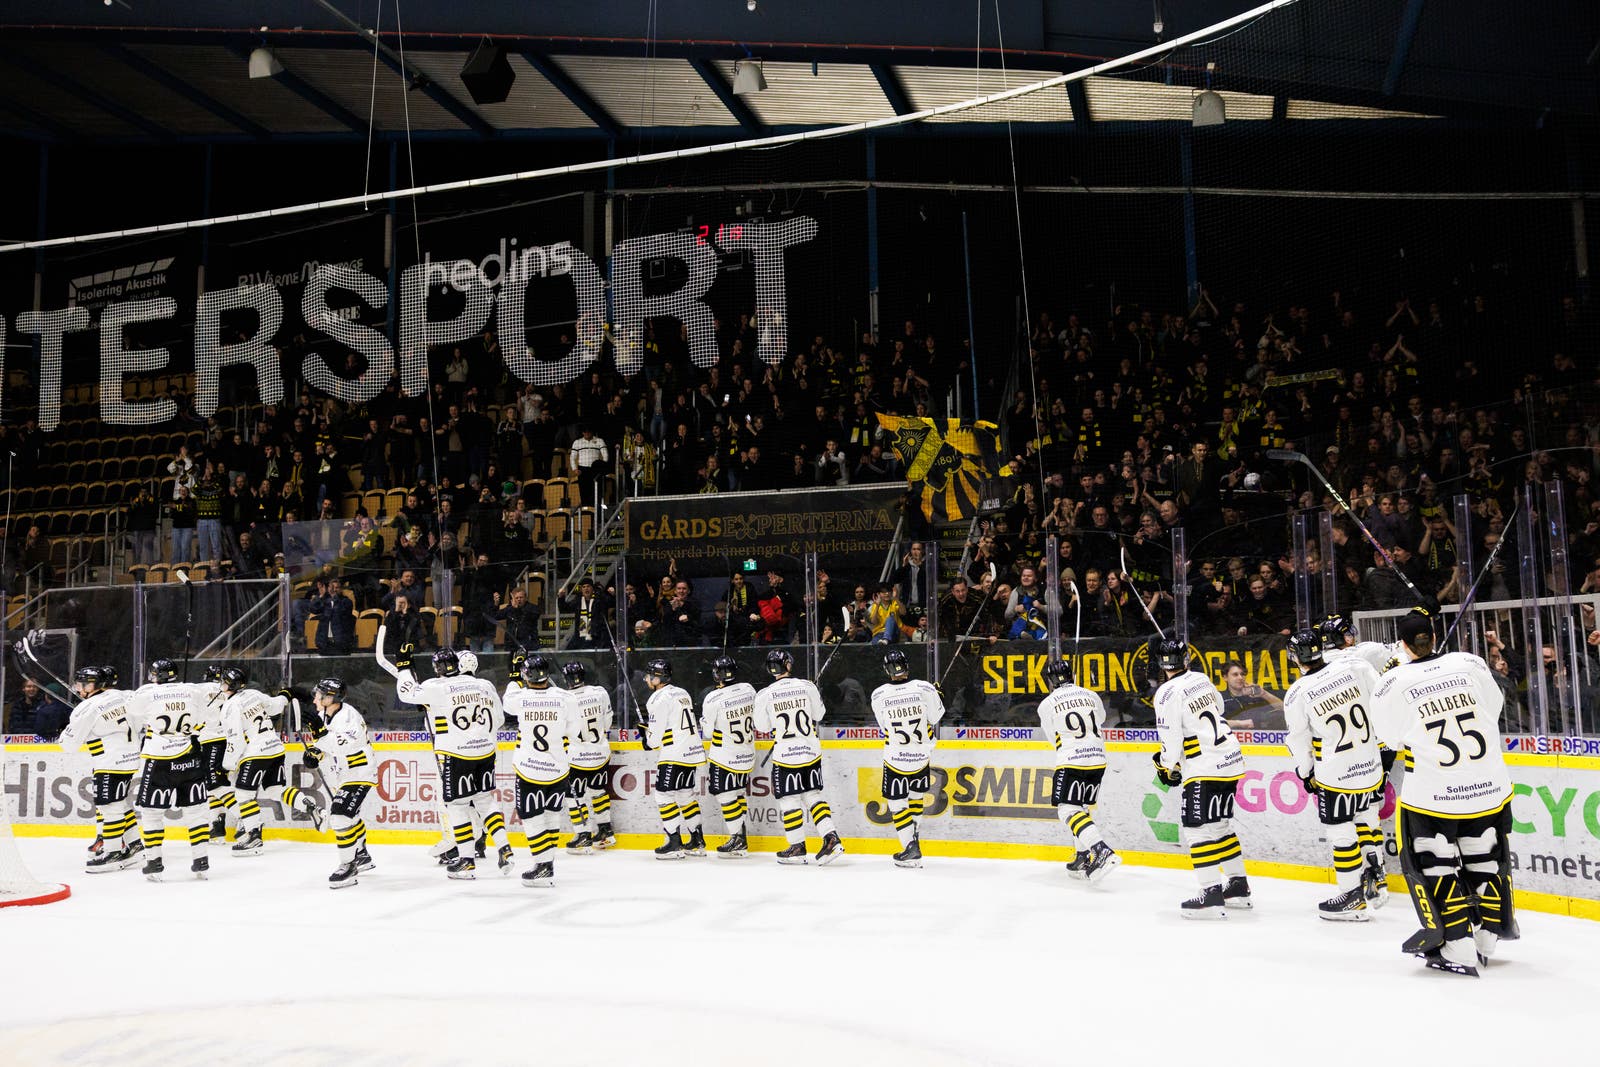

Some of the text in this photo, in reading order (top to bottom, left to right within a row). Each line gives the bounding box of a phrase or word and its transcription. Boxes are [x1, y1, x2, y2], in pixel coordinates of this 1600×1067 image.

[77, 284, 123, 303] Isolering
[126, 273, 168, 293] Akustik
[790, 541, 801, 553] &
[1307, 673, 1353, 700] Bemannia
[1409, 676, 1467, 699] Bemannia
[165, 702, 186, 711] NORD
[887, 704, 923, 719] SJÖBERG
[1313, 685, 1361, 717] LJUNGMAN
[1418, 692, 1477, 719] STÅLBERG
[524, 711, 558, 722] HEDBERG
[776, 709, 810, 739] 20
[1065, 709, 1101, 740] 91
[1325, 703, 1371, 754] 29
[533, 724, 549, 752] 8
[891, 718, 923, 746] 53
[966, 729, 1034, 739] INTERSPORT
[1425, 711, 1488, 768] 35
[170, 759, 195, 771] kopal
[1446, 780, 1494, 794] Sollentuna
[1415, 884, 1437, 930] CCM
